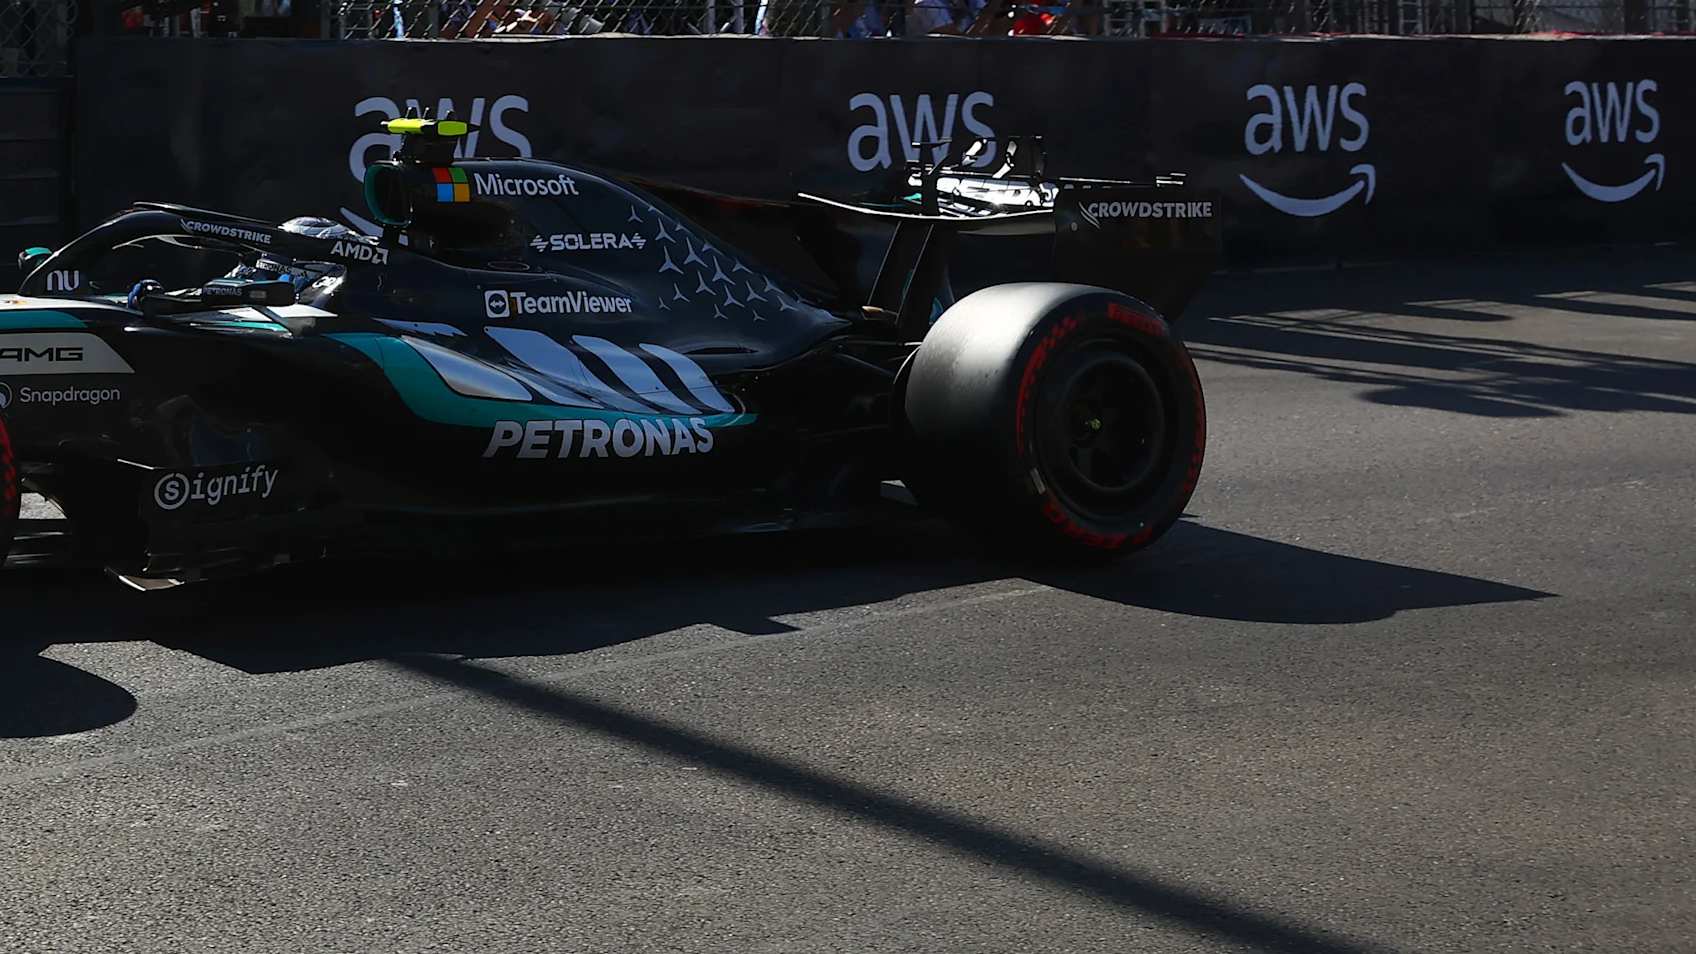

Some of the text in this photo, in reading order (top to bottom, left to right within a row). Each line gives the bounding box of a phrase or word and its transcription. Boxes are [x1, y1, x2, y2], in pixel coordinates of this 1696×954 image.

[1245, 82, 1371, 155] aws
[1565, 80, 1661, 146] aws
[474, 172, 579, 197] Microsoft
[1088, 201, 1213, 220] CROWDSTRIKE
[186, 219, 272, 245] CROWDSTRIKE
[550, 233, 630, 251] SOLERA
[330, 240, 374, 262] AMD
[46, 269, 81, 292] nu
[511, 290, 632, 315] TeamViewer
[19, 386, 121, 407] Snapdragon
[482, 418, 714, 459] PETRONAS
